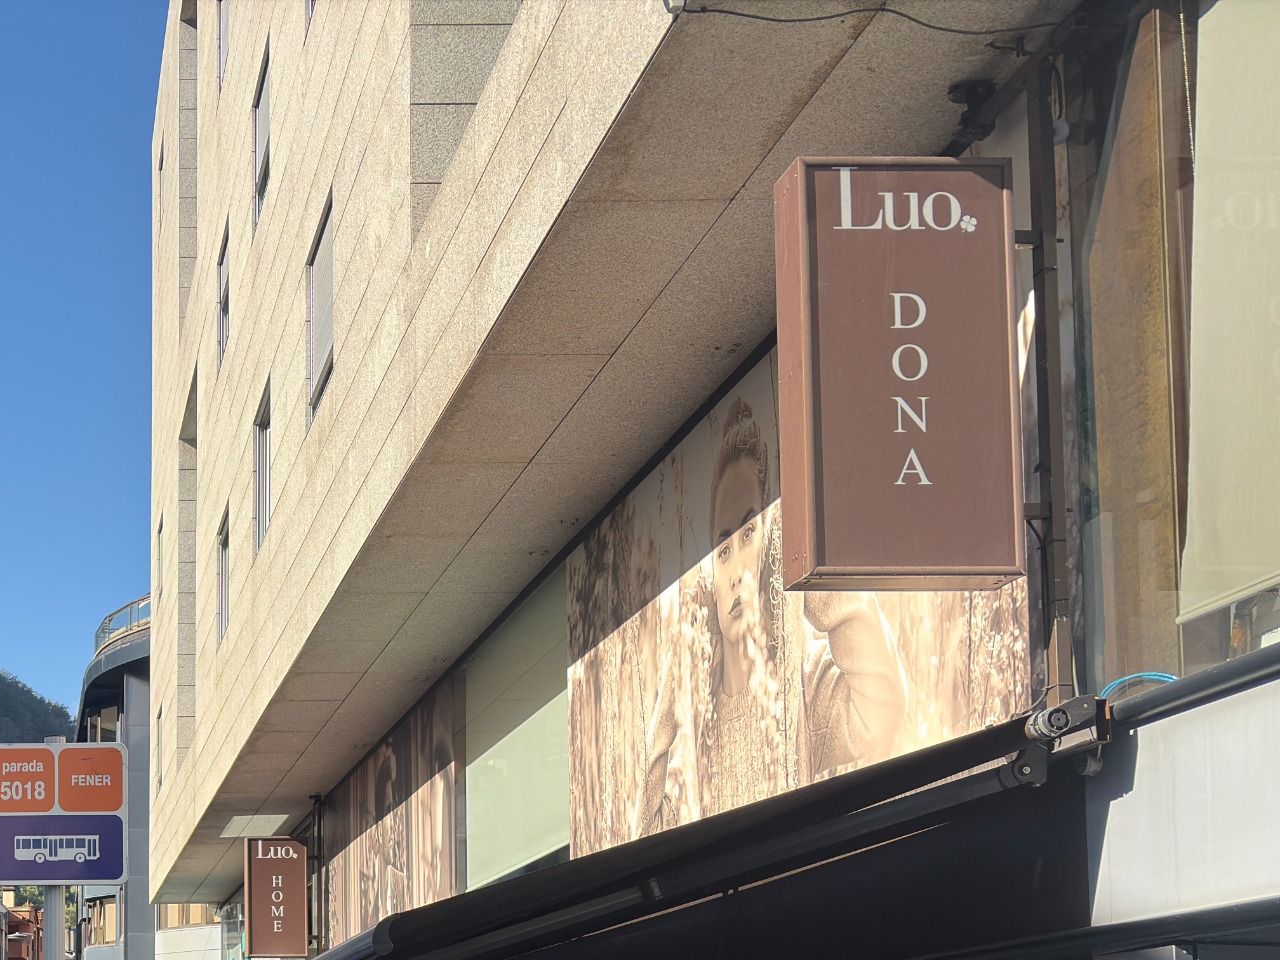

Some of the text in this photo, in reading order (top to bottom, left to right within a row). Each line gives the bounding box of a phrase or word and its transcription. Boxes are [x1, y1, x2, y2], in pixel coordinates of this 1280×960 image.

[889, 292, 933, 485] DONA
[2, 760, 44, 775] parada
[71, 774, 111, 786] FENER
[0, 781, 46, 800] 5018
[271, 876, 284, 932] HOME
